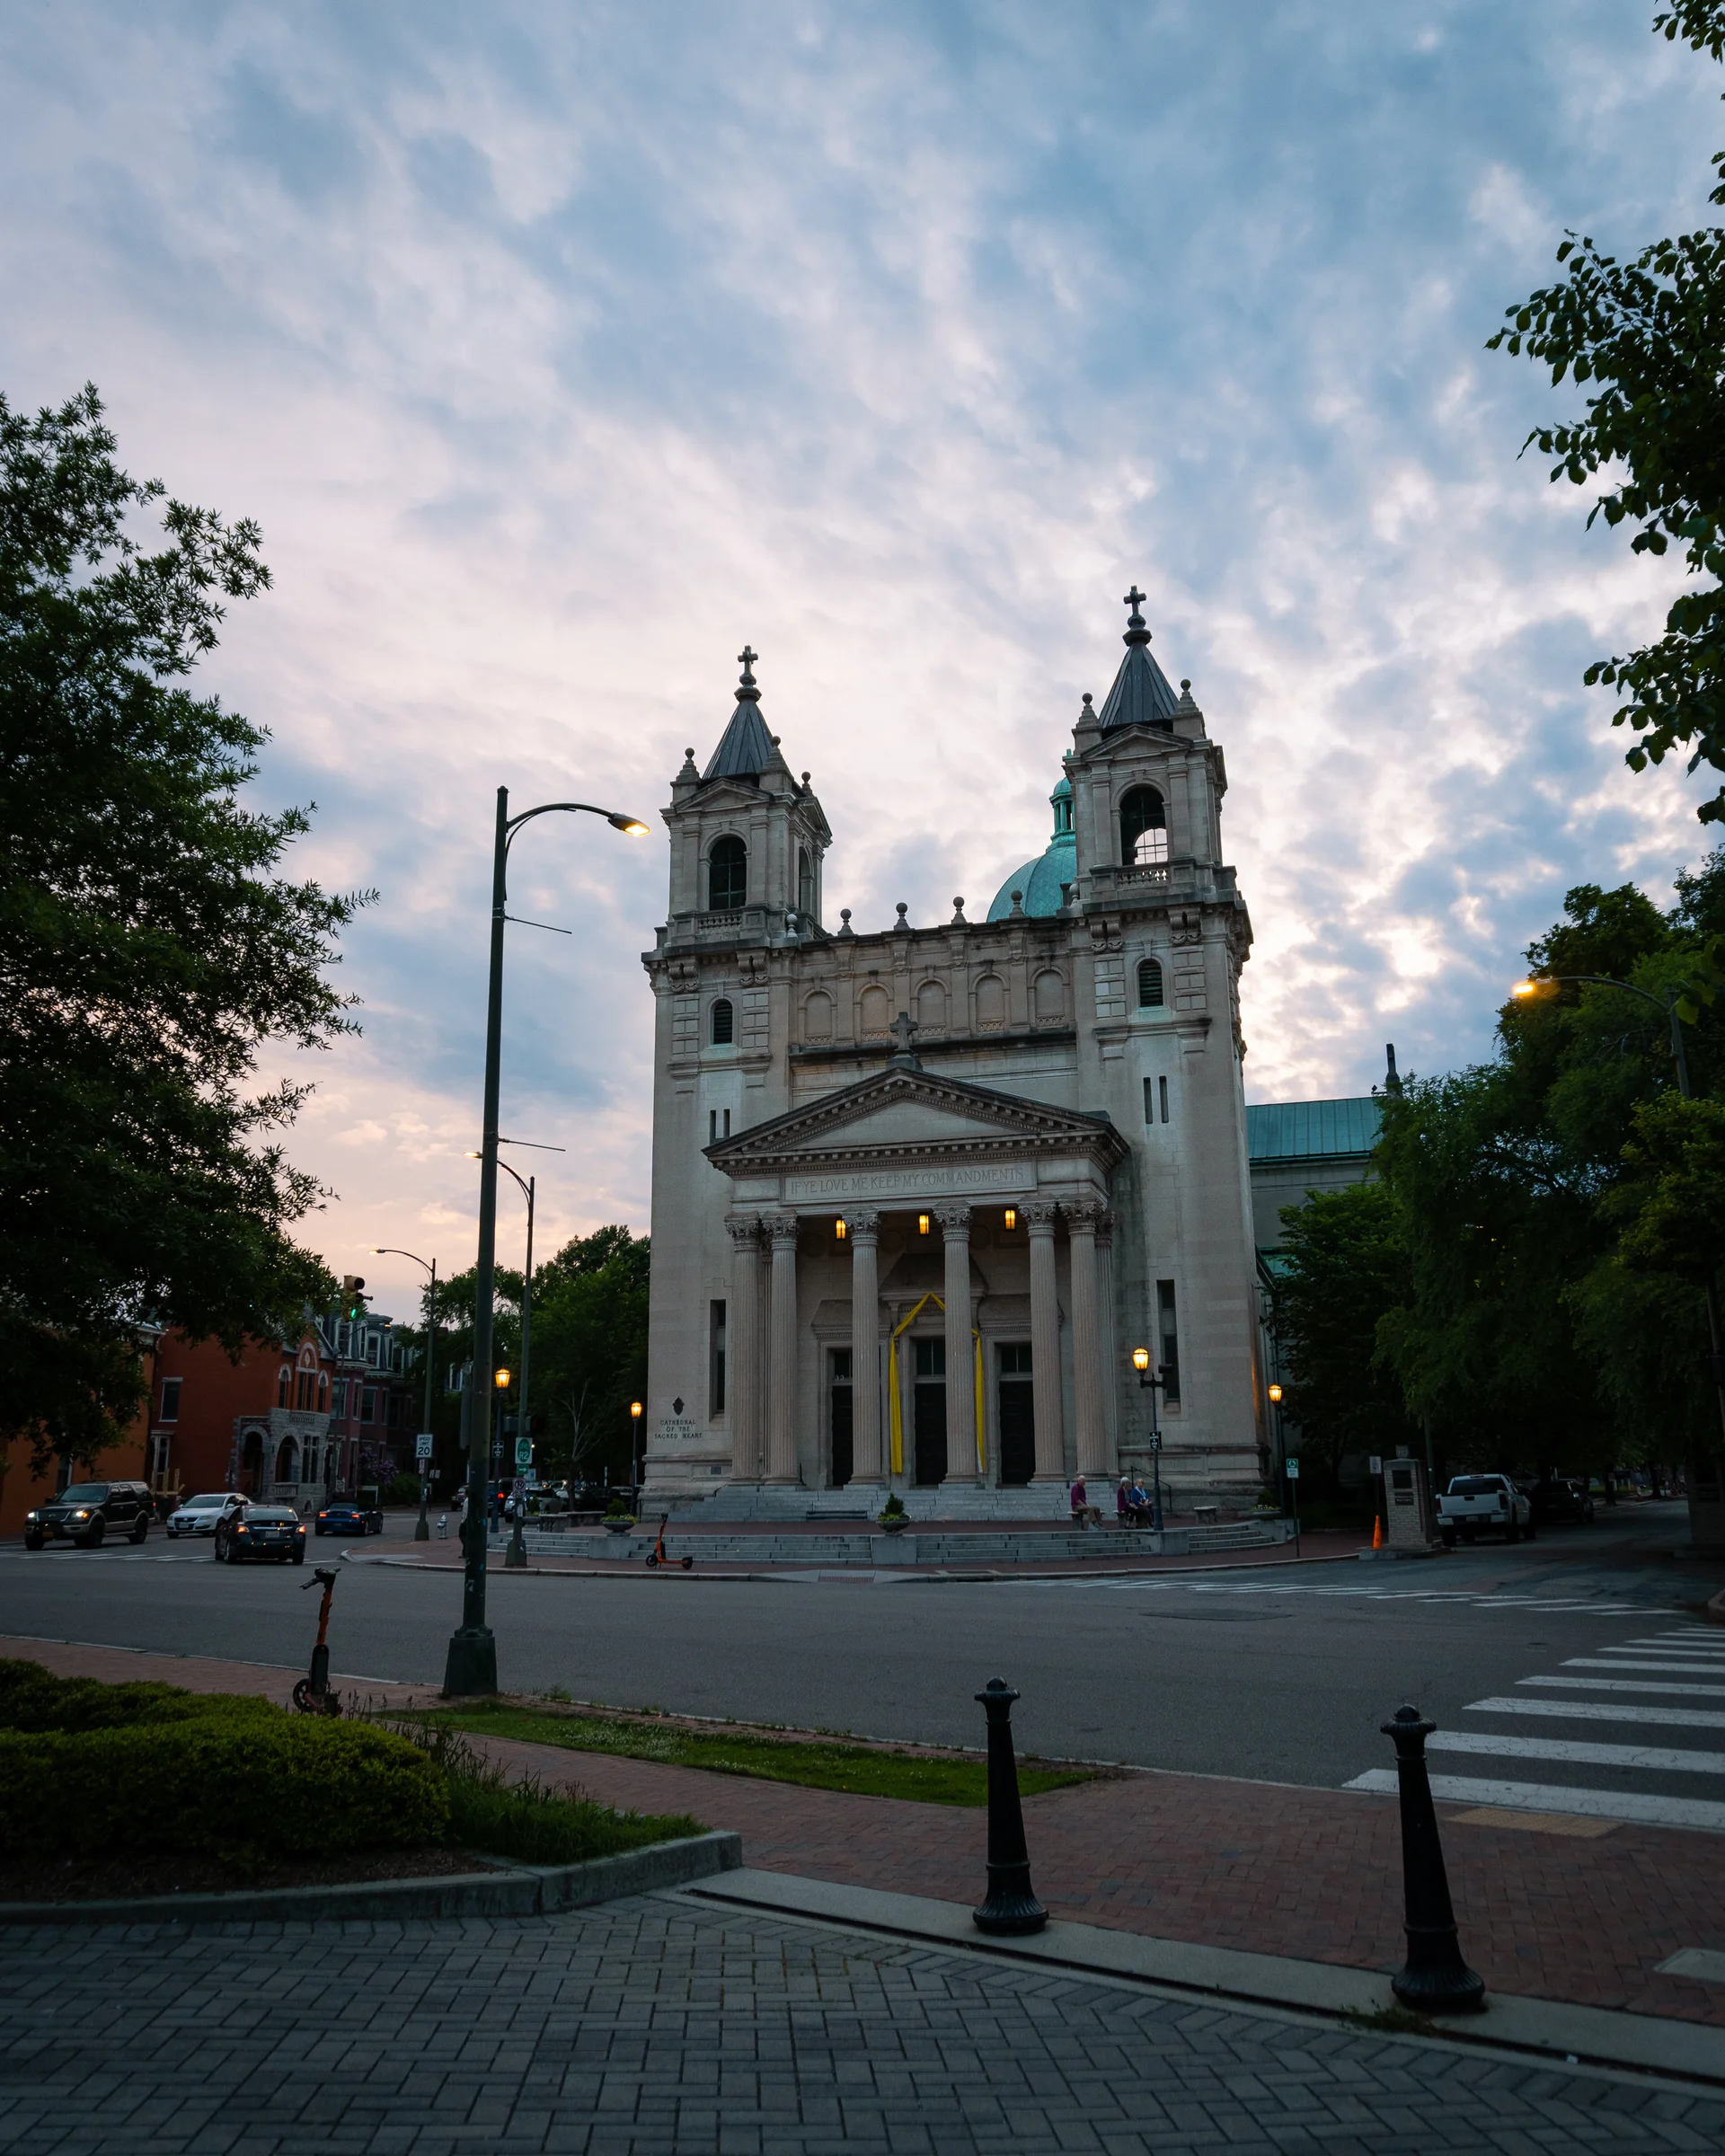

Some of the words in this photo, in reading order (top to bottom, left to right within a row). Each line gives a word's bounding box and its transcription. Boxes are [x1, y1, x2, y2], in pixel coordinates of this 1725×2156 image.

[791, 1181, 801, 1194] IF
[803, 1180, 818, 1193] YE
[820, 1179, 849, 1192] LOVE
[852, 1177, 869, 1190] ME
[871, 1176, 900, 1189] KEEP
[903, 1174, 920, 1187] MY
[921, 1168, 1023, 1186] COMMANDMENTS
[418, 1446, 429, 1455] 20
[518, 1452, 528, 1460] R2
